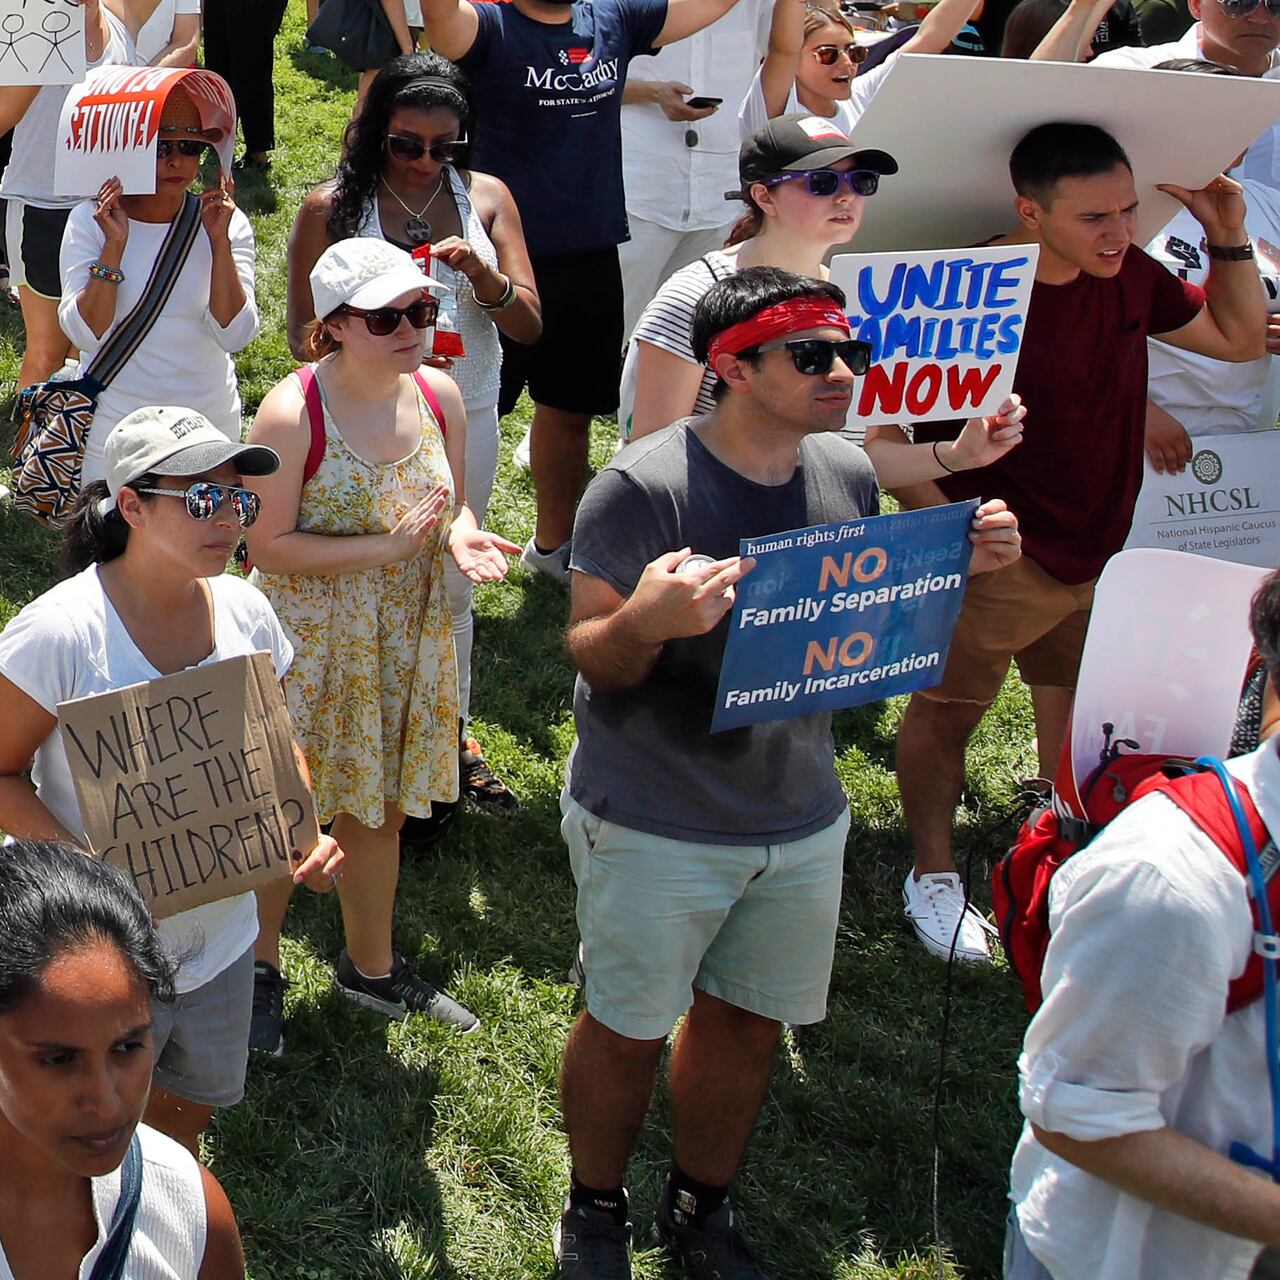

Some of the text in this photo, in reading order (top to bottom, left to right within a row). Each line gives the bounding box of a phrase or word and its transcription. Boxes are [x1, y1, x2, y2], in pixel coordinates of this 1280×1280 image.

[524, 58, 618, 91] McCarthy
[858, 257, 1028, 319] UNITE
[857, 362, 1002, 417] NOW
[1164, 487, 1260, 517] NHCSL
[746, 523, 865, 557] human rights first
[1157, 520, 1276, 539] National Hispanic Caucus
[1190, 536, 1260, 551] State Legislators
[817, 547, 888, 592] NO
[739, 572, 962, 629] Family Separation
[802, 631, 874, 676] NO
[724, 651, 940, 709] Family Incarceration
[65, 690, 224, 779] WHERE
[112, 746, 271, 840] ARE THE
